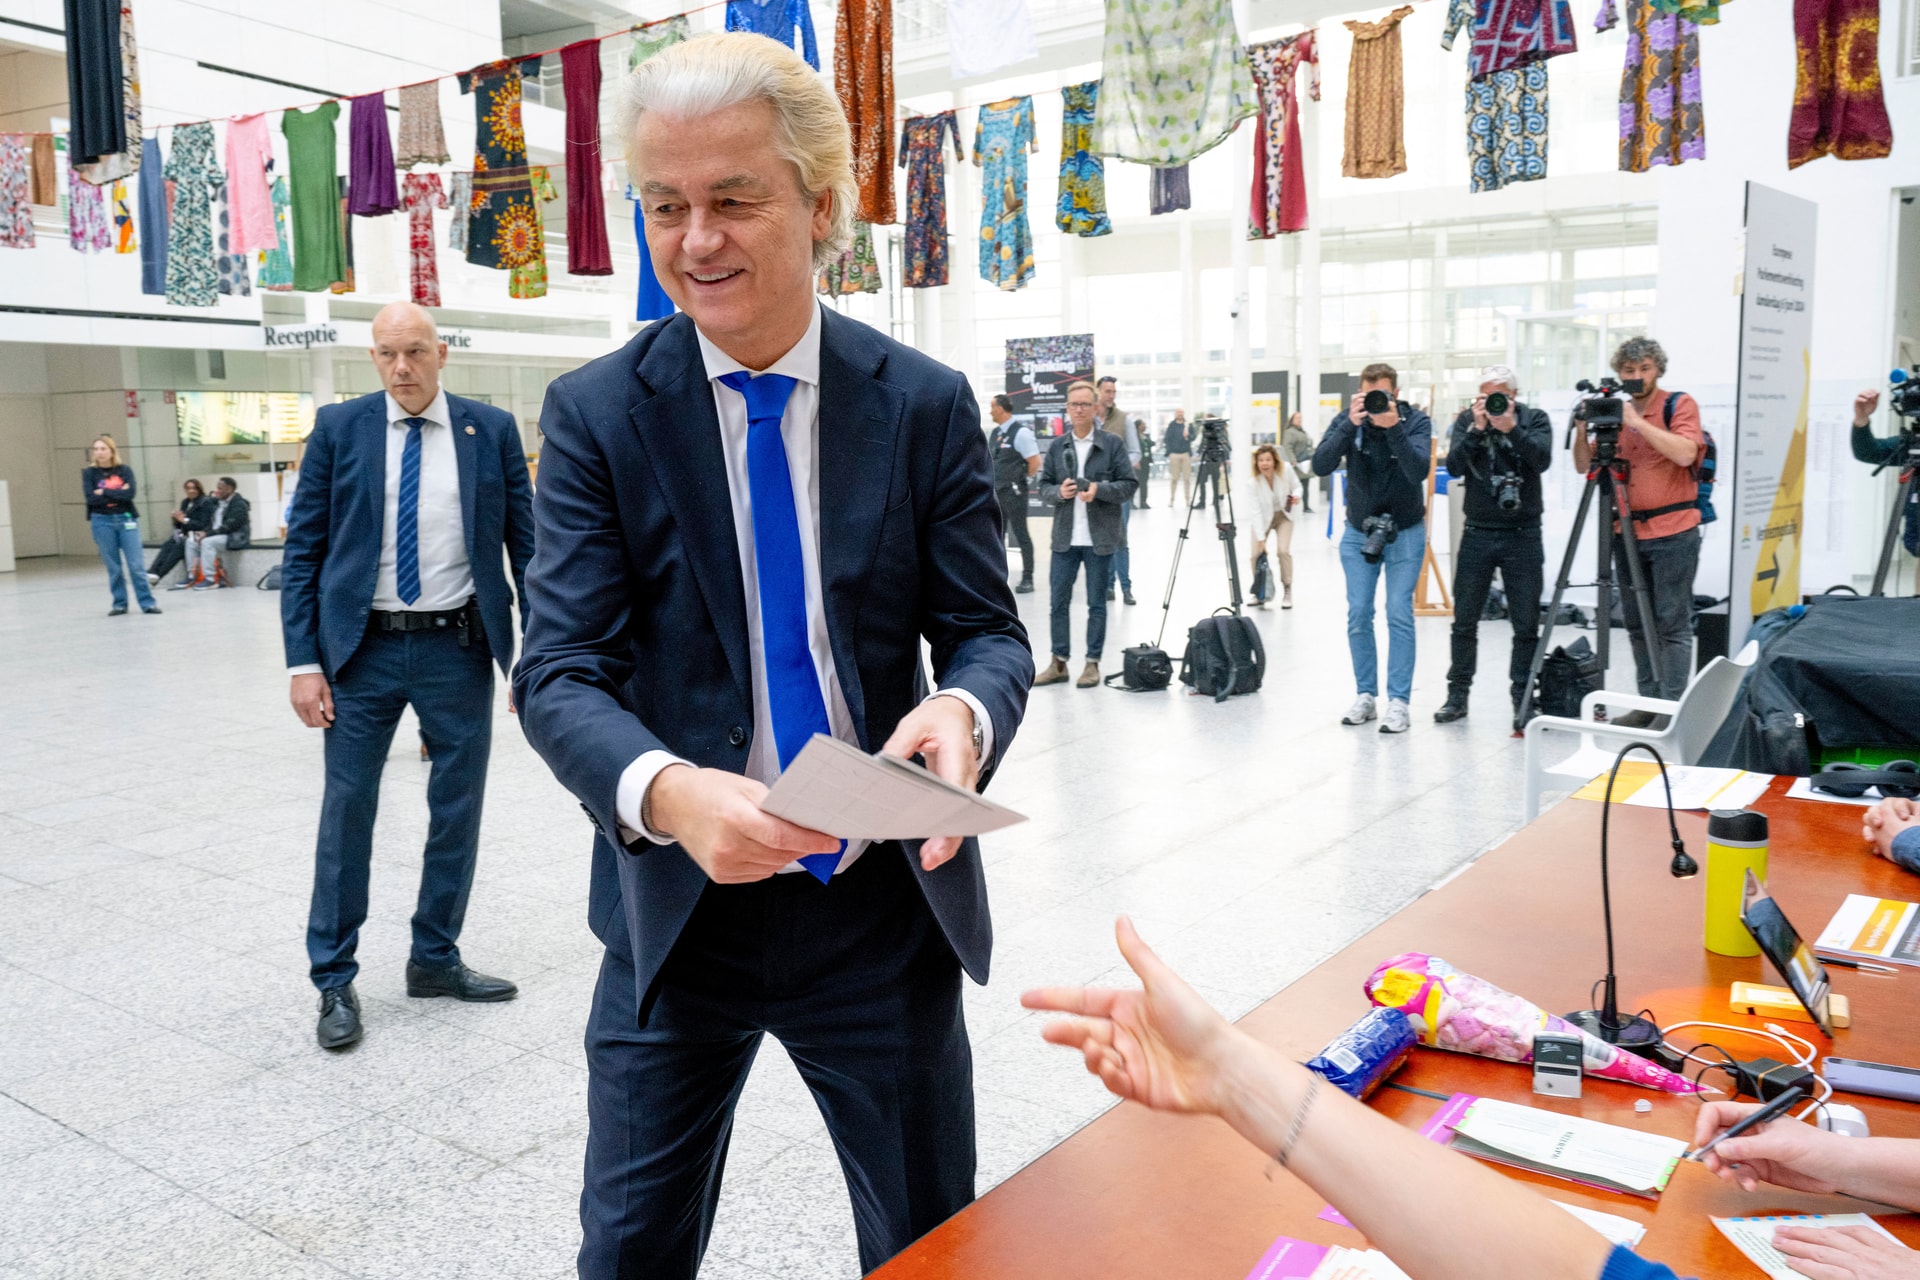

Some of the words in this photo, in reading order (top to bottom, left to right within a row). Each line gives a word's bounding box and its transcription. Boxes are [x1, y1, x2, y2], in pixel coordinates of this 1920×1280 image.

[264, 324, 337, 349] Receptie
[1023, 360, 1076, 374] Thinking
[1022, 371, 1035, 385] of
[1031, 382, 1058, 394] You.
